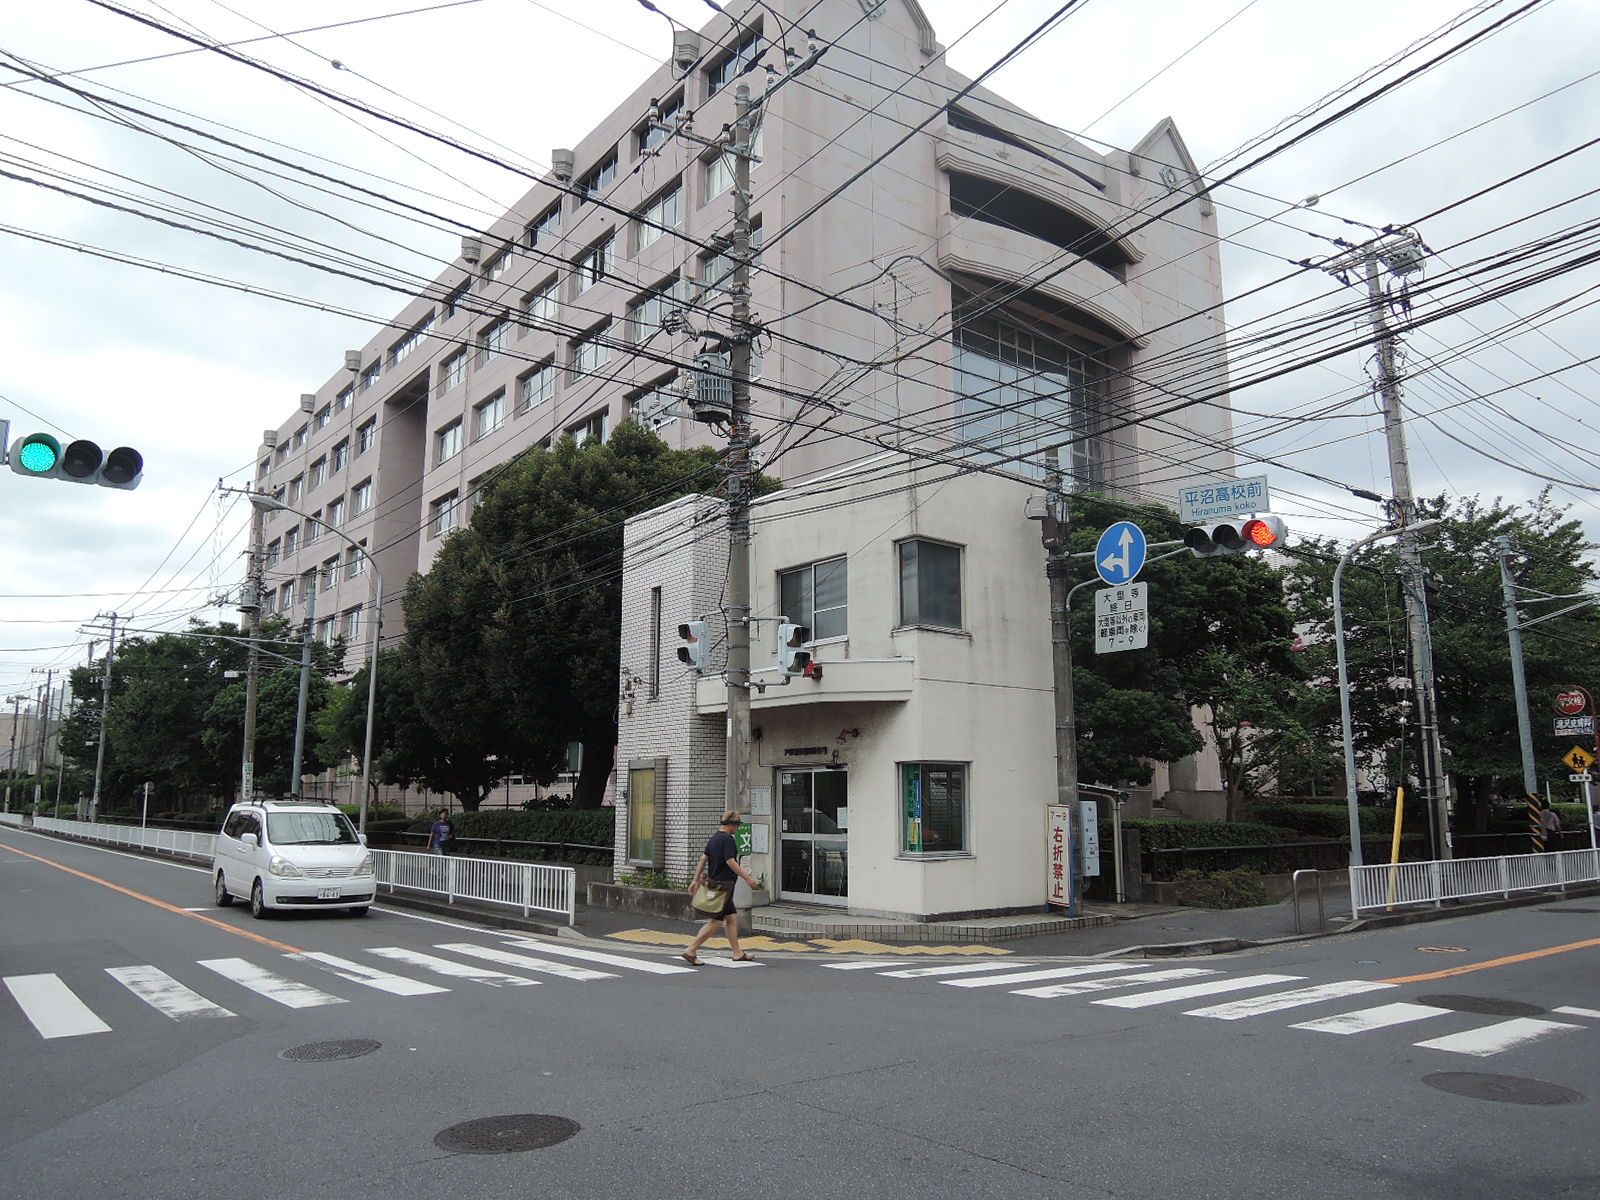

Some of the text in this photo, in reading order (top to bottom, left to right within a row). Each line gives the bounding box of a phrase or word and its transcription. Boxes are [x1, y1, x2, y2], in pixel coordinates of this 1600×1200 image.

[1184, 482, 1262, 506] 平沼高校前
[1191, 502, 1257, 517] Hiranuma koko
[1103, 588, 1139, 603] 大型等
[1110, 600, 1132, 612] 終日
[1053, 826, 1064, 898] 右折禁止
